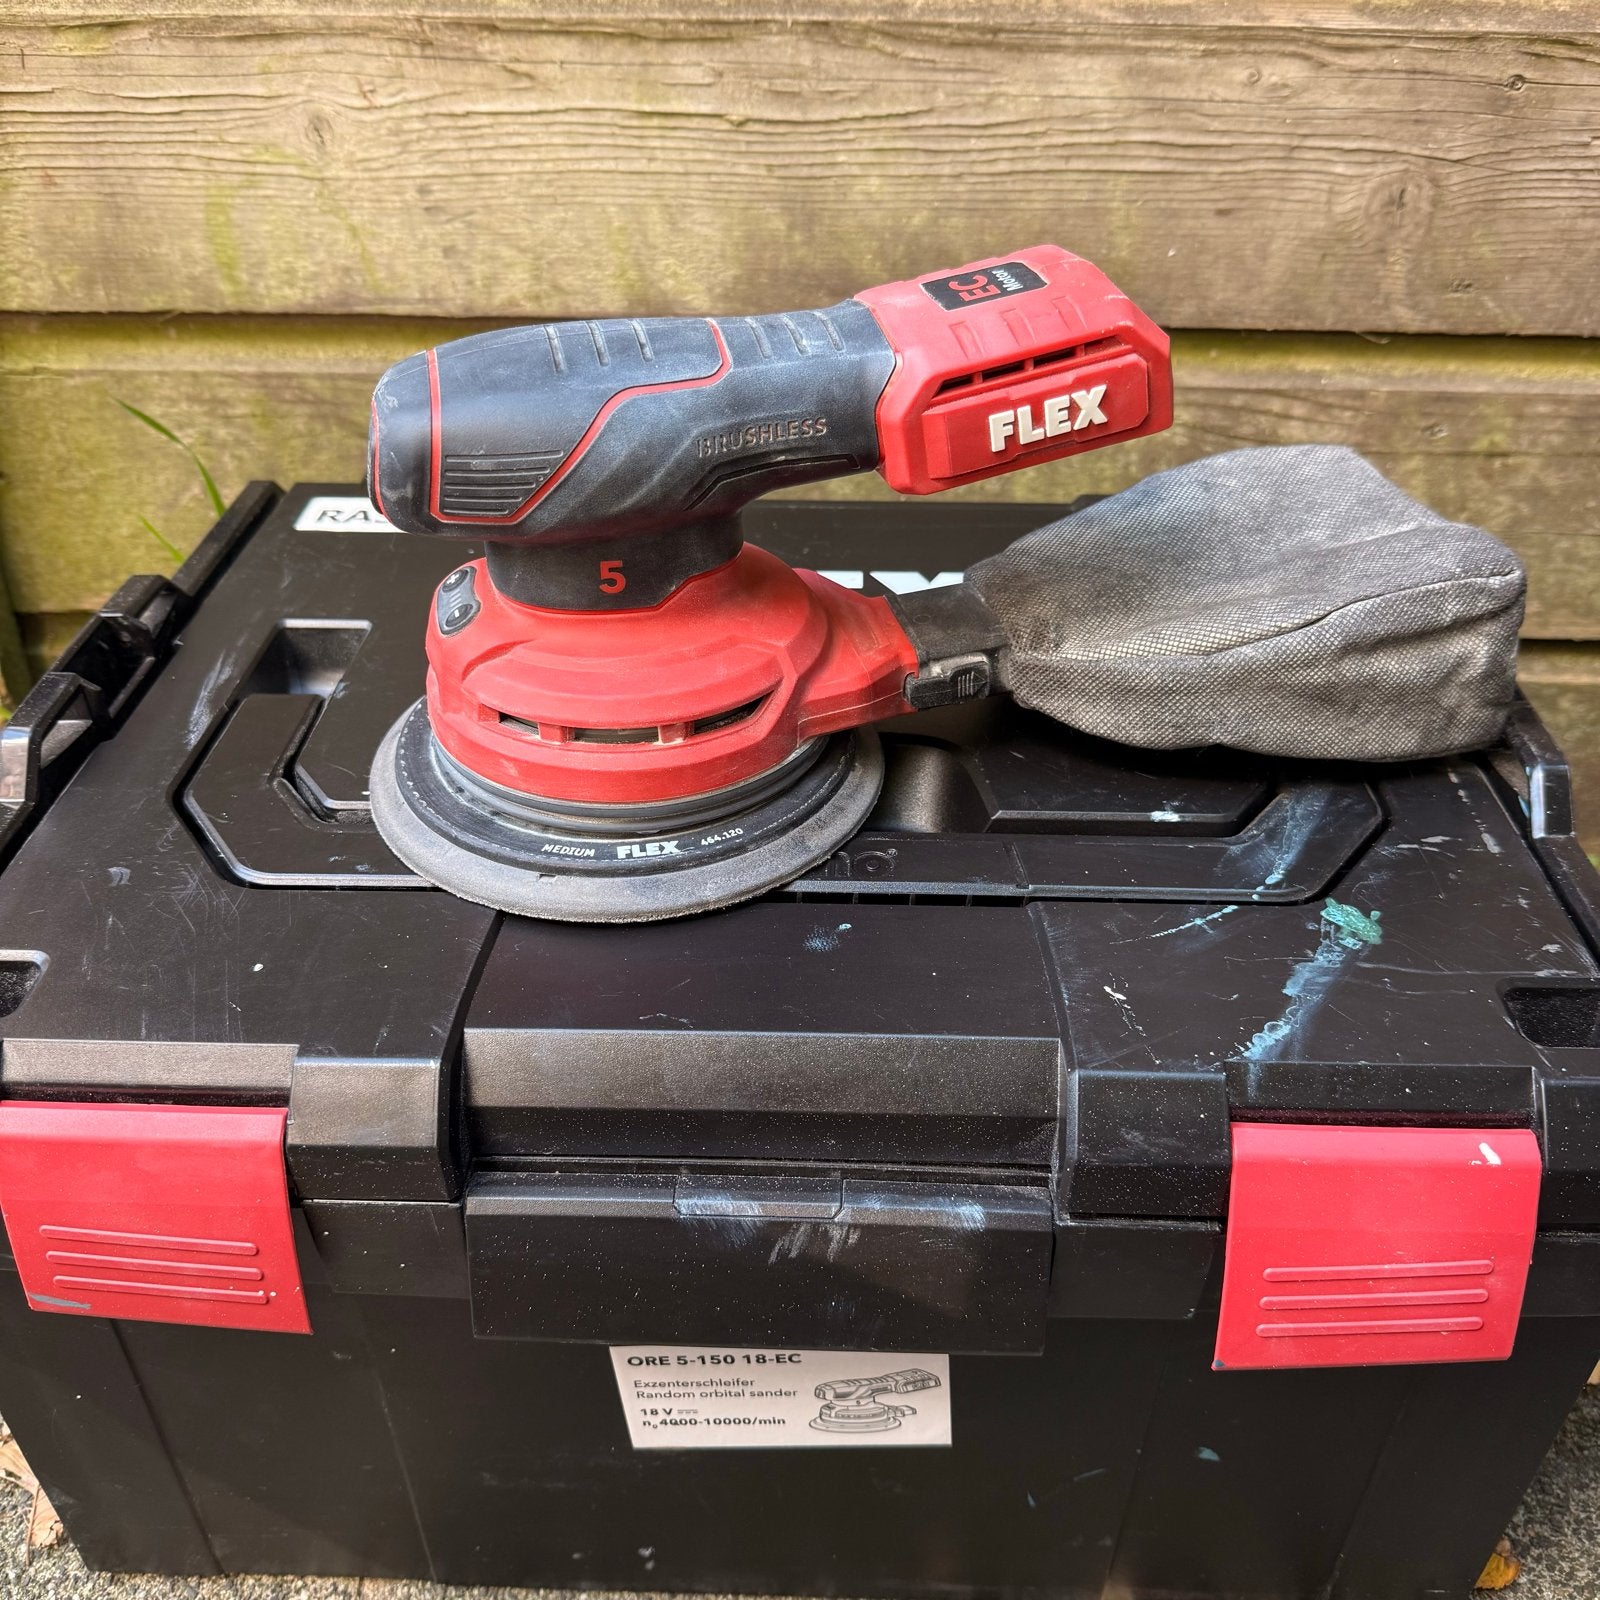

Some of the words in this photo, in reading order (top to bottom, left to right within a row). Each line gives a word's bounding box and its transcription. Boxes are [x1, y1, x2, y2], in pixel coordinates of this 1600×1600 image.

[948, 275, 1001, 302] EC
[991, 268, 1023, 292] Motor
[988, 384, 1108, 452] FLEX
[696, 417, 828, 458] BRUSHLESS
[316, 509, 389, 523] RA
[599, 560, 626, 594] 5
[542, 843, 596, 858] MEDIUM
[616, 840, 680, 859] FLEX
[700, 827, 744, 846] 464.120
[627, 1356, 671, 1367] ORE
[676, 1354, 736, 1366] 5-150
[742, 1353, 802, 1365] 18-EC
[633, 1378, 756, 1388] Exzenterschleifer
[636, 1390, 696, 1399] Random
[699, 1389, 746, 1398] orbital
[749, 1388, 798, 1397] sander
[640, 1408, 659, 1416] 18
[662, 1408, 673, 1416] V
